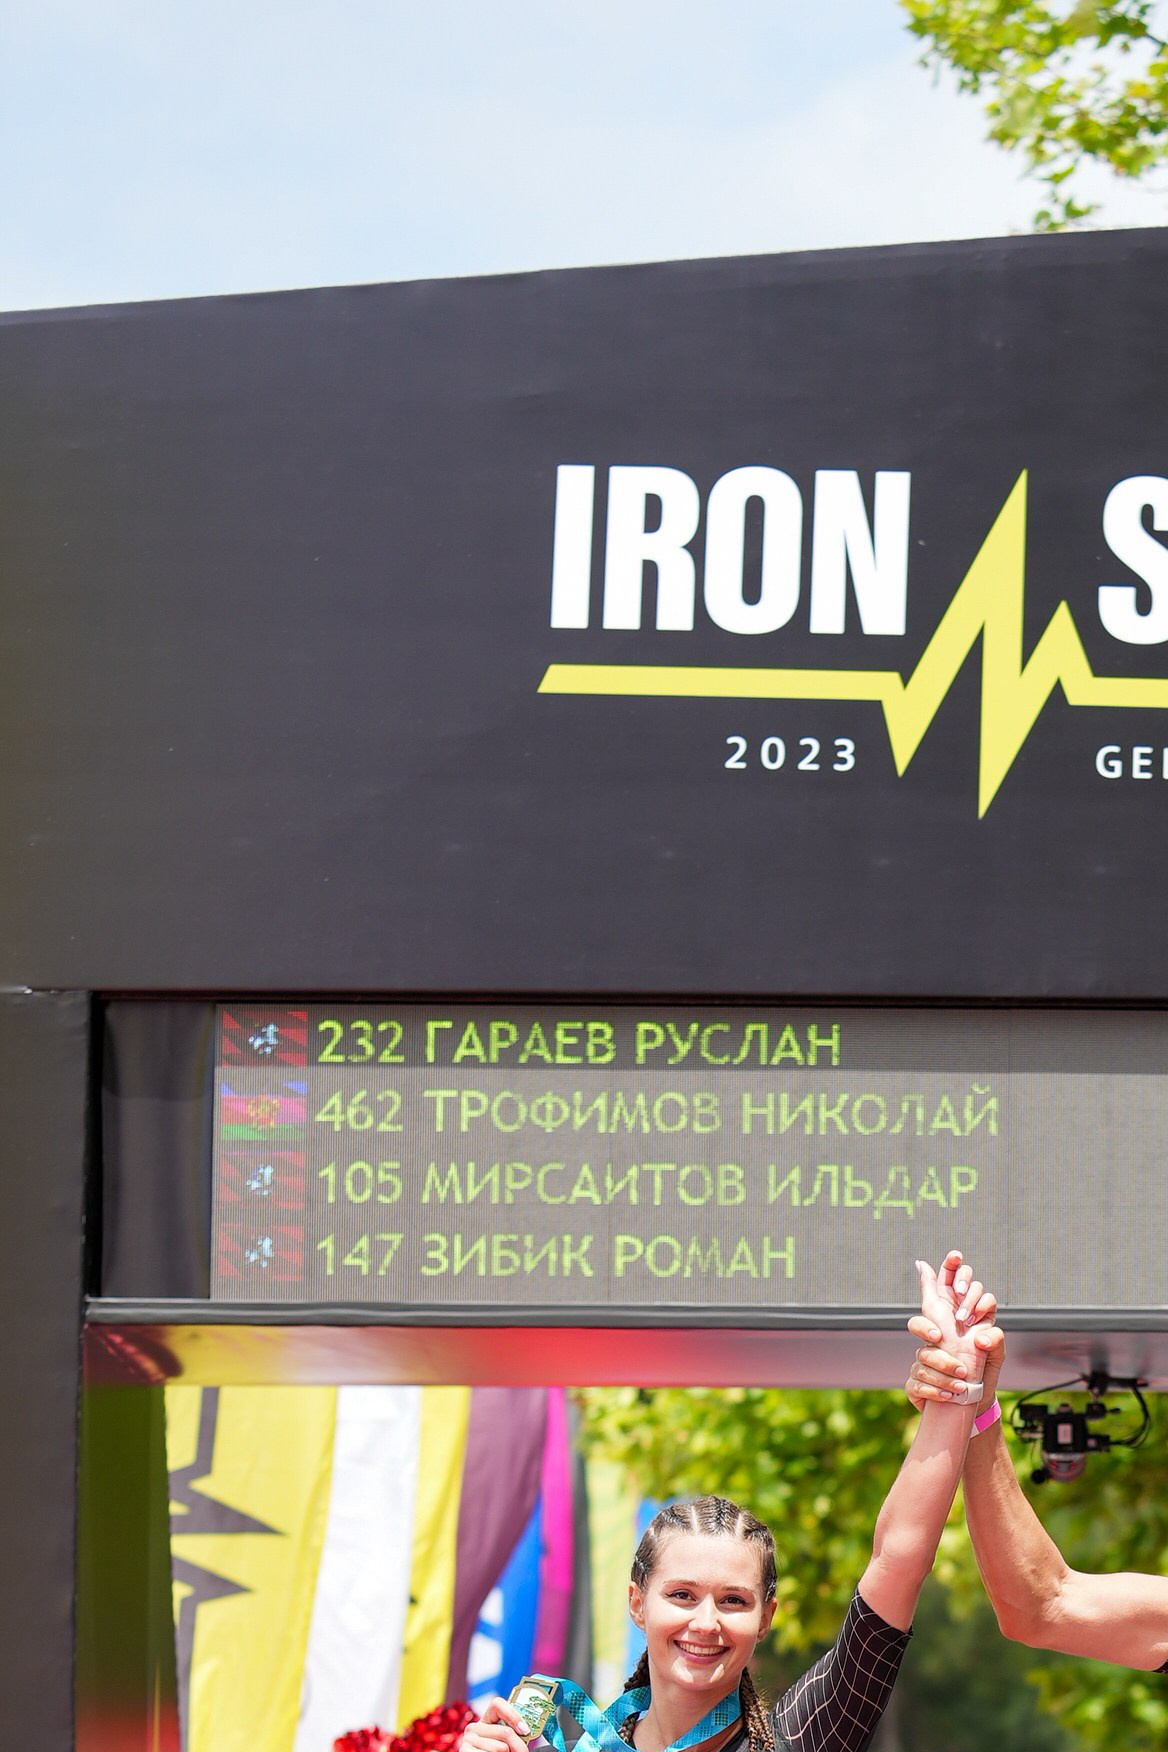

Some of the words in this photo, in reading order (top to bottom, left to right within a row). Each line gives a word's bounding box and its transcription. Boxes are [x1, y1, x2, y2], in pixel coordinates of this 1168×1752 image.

[550, 464, 911, 636] IRON
[723, 735, 858, 772] 2023
[317, 1021, 403, 1064] 232
[424, 1021, 616, 1065] ГАРАЕВ
[635, 1022, 841, 1067] РУСЛАН
[315, 1090, 403, 1134] 462
[423, 1090, 721, 1135] ТРОФИМОВ
[742, 1083, 998, 1137] НИКОЛАЙ
[318, 1162, 402, 1205] 105
[422, 1162, 746, 1206] МИРСАИТОВ
[767, 1164, 978, 1218] ИЛЬДАР
[317, 1233, 403, 1277] 147
[422, 1232, 593, 1277] ЗИБИК
[614, 1234, 796, 1279] РОМАН
